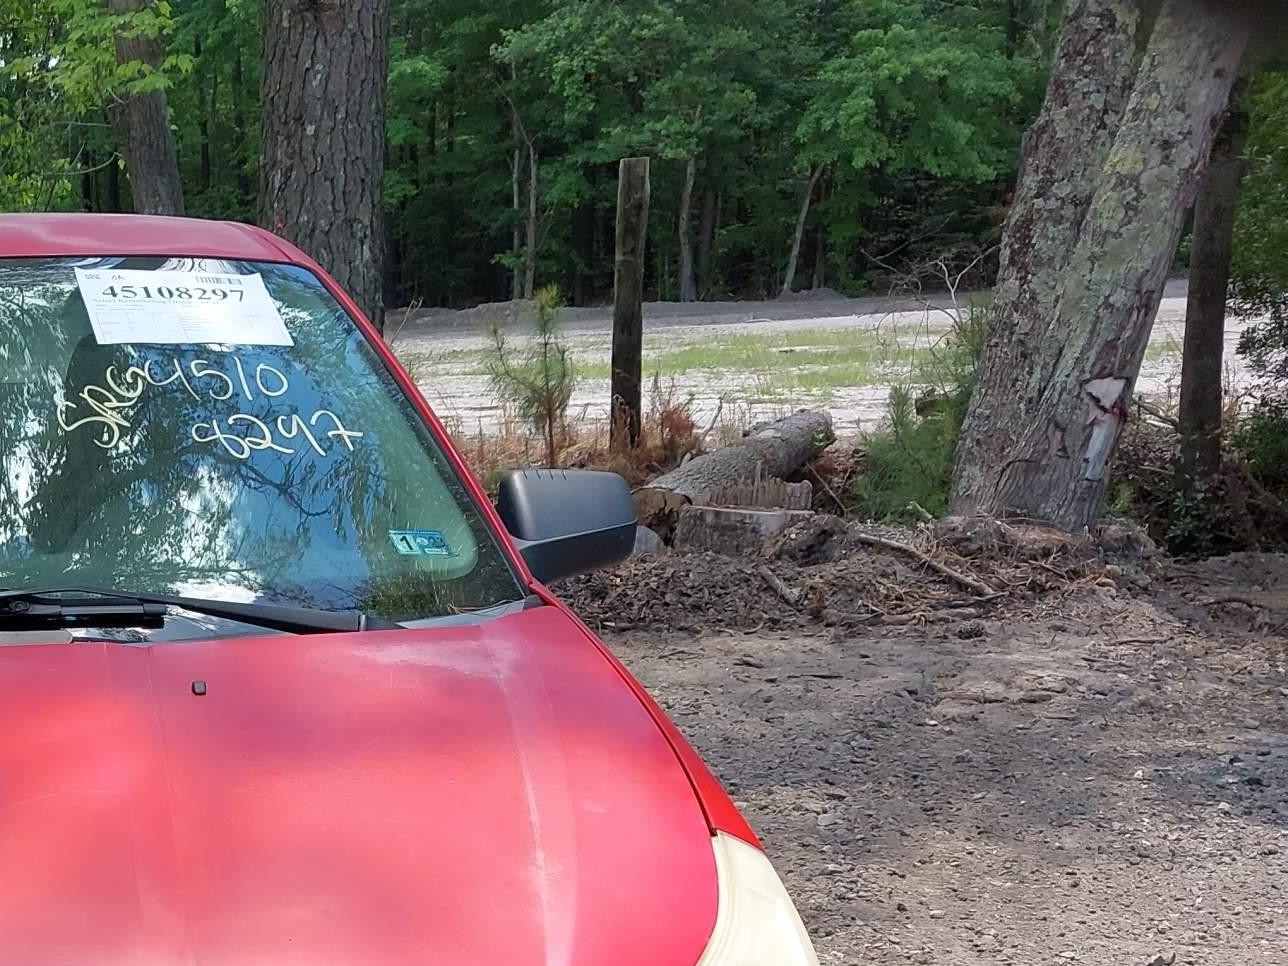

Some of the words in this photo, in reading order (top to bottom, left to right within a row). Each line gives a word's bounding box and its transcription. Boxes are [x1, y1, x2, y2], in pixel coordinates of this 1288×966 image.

[102, 285, 244, 302] 45108297
[144, 355, 289, 401] 4510
[191, 410, 364, 459] 8297
